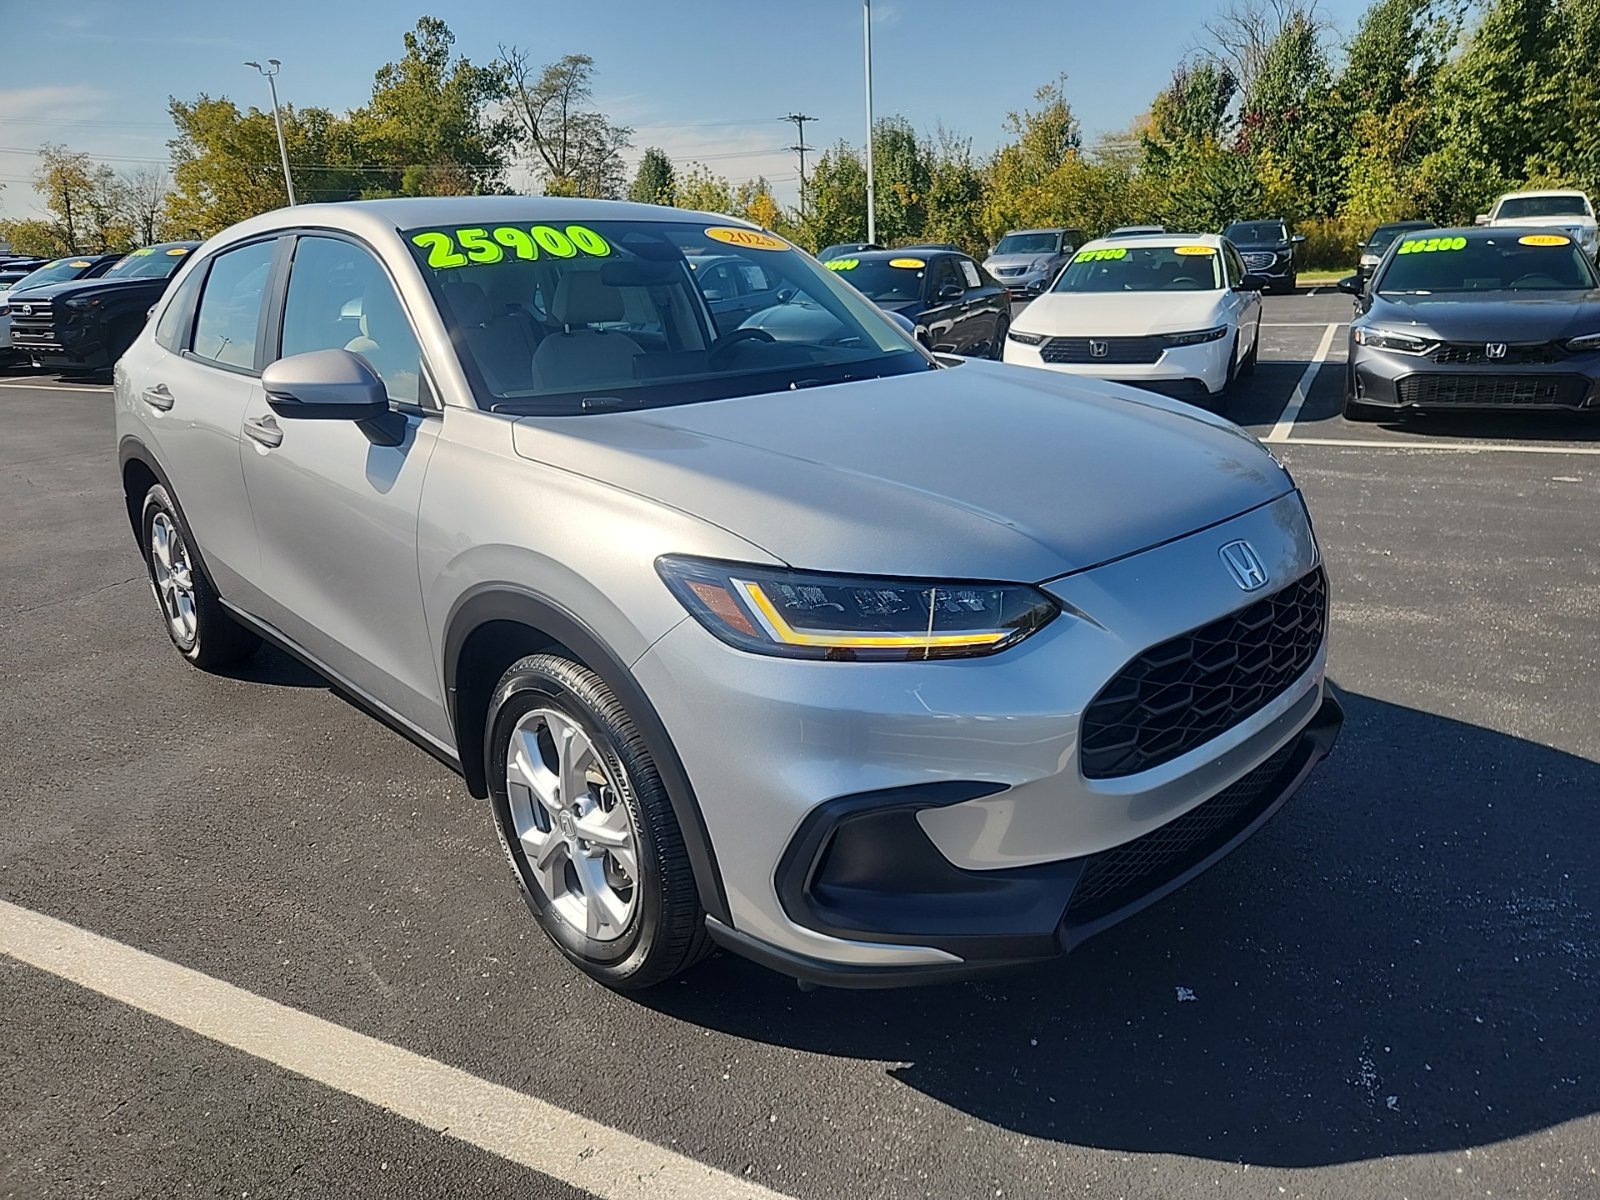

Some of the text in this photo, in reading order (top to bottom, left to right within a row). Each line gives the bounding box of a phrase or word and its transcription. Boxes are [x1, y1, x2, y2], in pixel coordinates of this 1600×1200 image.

[411, 225, 611, 269] 25900
[723, 230, 776, 247] 2025
[1397, 236, 1467, 255] 26200
[1073, 247, 1128, 264] 27900
